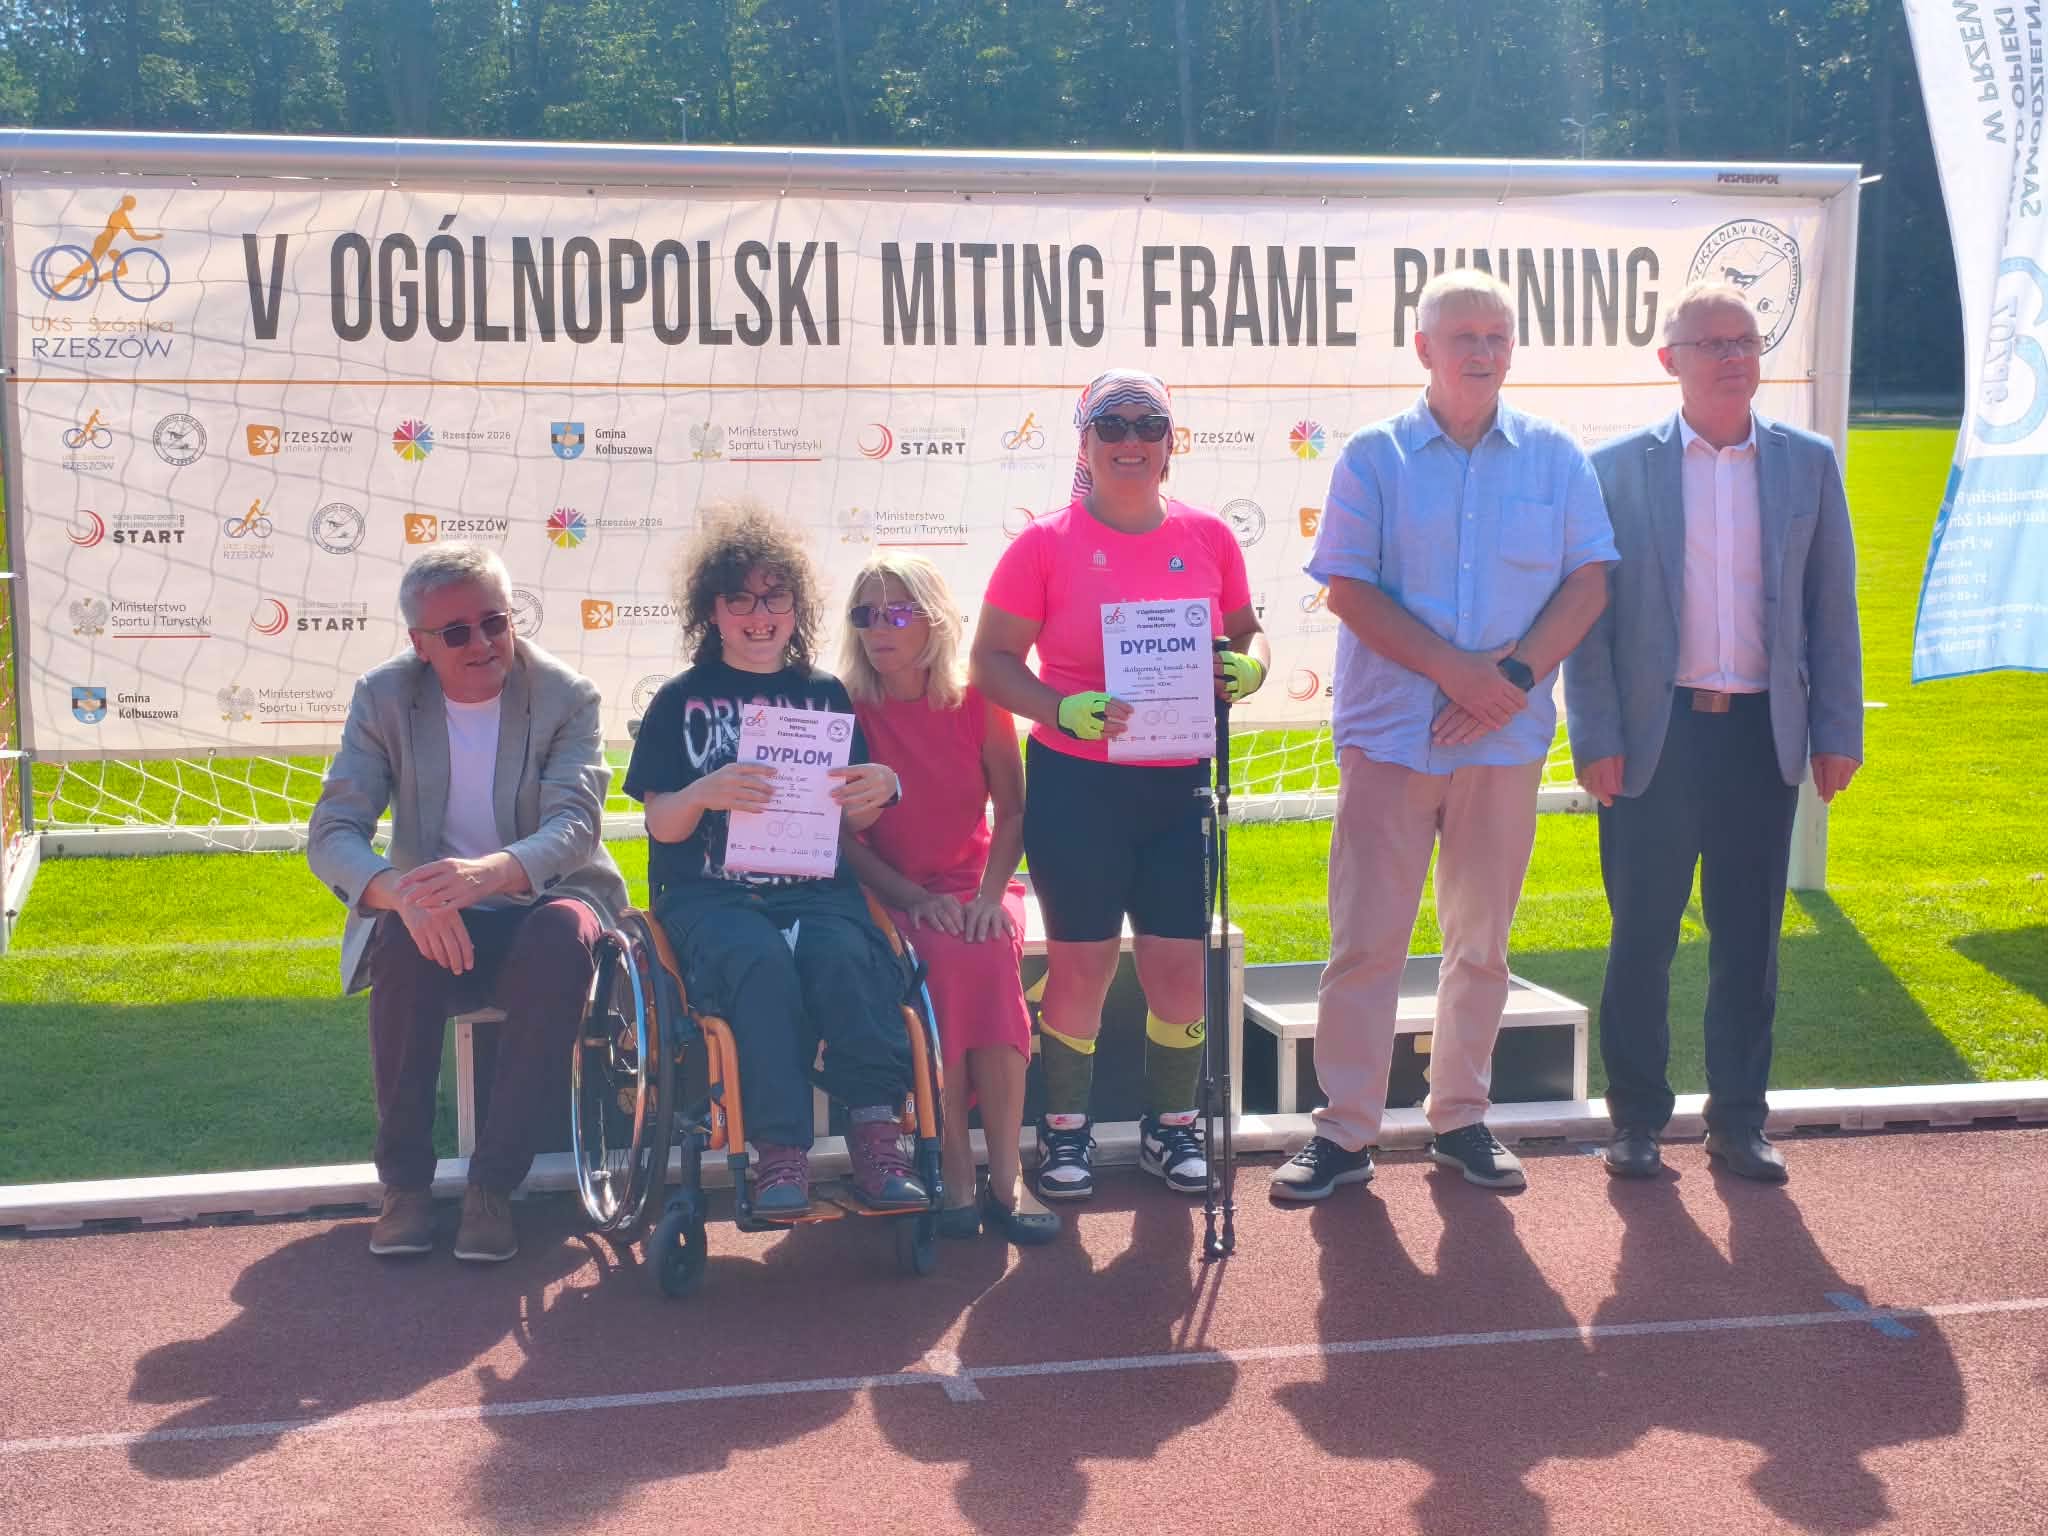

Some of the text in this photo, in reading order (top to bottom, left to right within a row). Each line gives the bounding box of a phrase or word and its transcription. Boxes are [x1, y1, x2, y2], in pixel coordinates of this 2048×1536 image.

[242, 214, 1660, 347] V OGÓLNOPOLSKI MITING FRAME RNING
[32, 314, 174, 333] UKS Szóstka
[32, 335, 174, 359] RZESZÓW
[284, 430, 353, 444] rzeszów
[442, 430, 511, 440] Rzeszów 2026
[595, 428, 626, 439] Gmina
[728, 426, 799, 437] Ministerstwo
[1193, 429, 1255, 443] rzeszów
[595, 444, 653, 456] Kolbuszowa
[728, 440, 764, 452] Sportu
[774, 440, 822, 452] Turystyki
[900, 442, 966, 456] START
[876, 511, 945, 521] Ministerstwo
[441, 517, 508, 532] rzeszów
[639, 518, 663, 528] 2026
[876, 524, 912, 536] Sportu
[921, 524, 969, 536] Turystyki
[113, 529, 185, 544] START
[111, 601, 186, 612] Ministerstwo
[111, 615, 150, 628] Sportu
[160, 615, 212, 628] Turystyki
[297, 617, 368, 631] START
[1120, 637, 1196, 655] DYPLOM
[117, 693, 150, 704] Gmina
[259, 688, 334, 699] Ministerstwo
[118, 708, 179, 720] Kolbuszowa
[259, 702, 297, 714] Sportu
[307, 702, 351, 714] Turysty
[756, 744, 833, 767] DYPLOM
